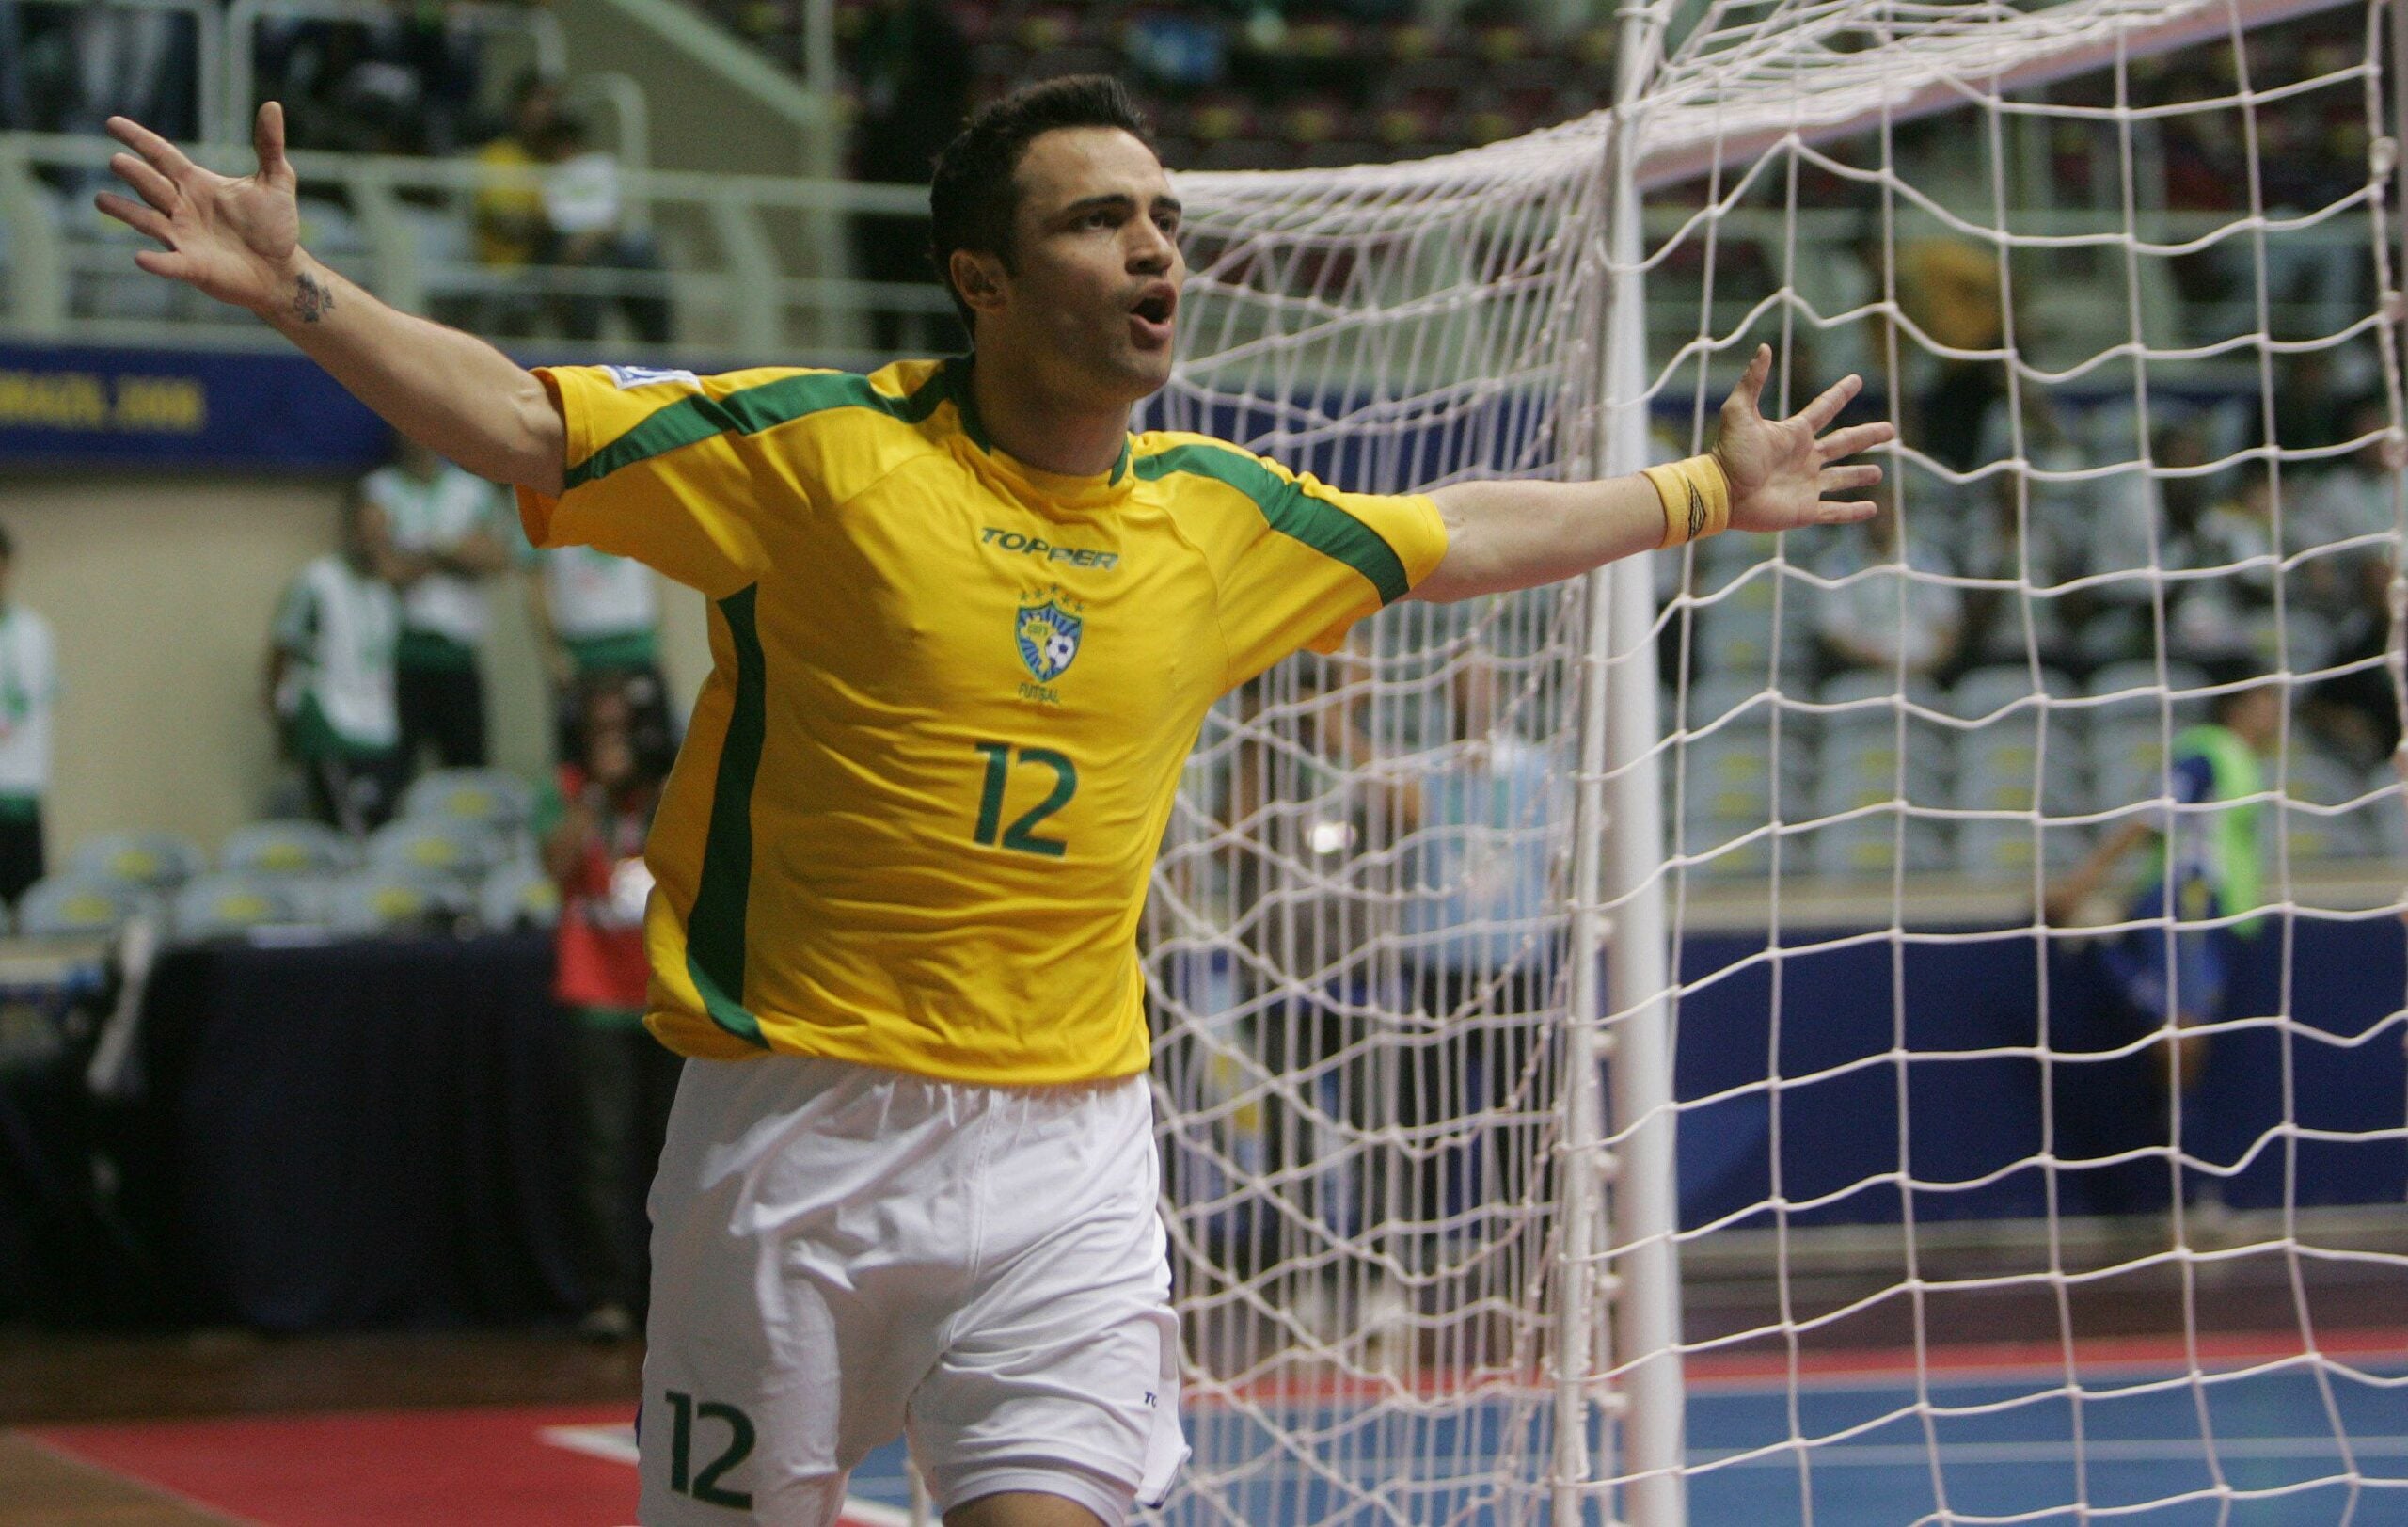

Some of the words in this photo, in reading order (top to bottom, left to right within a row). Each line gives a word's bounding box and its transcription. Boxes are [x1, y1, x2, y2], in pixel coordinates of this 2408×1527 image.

[982, 527, 1119, 571] TOPPER
[973, 740, 1078, 857] 12
[665, 1389, 756, 1510] 12
